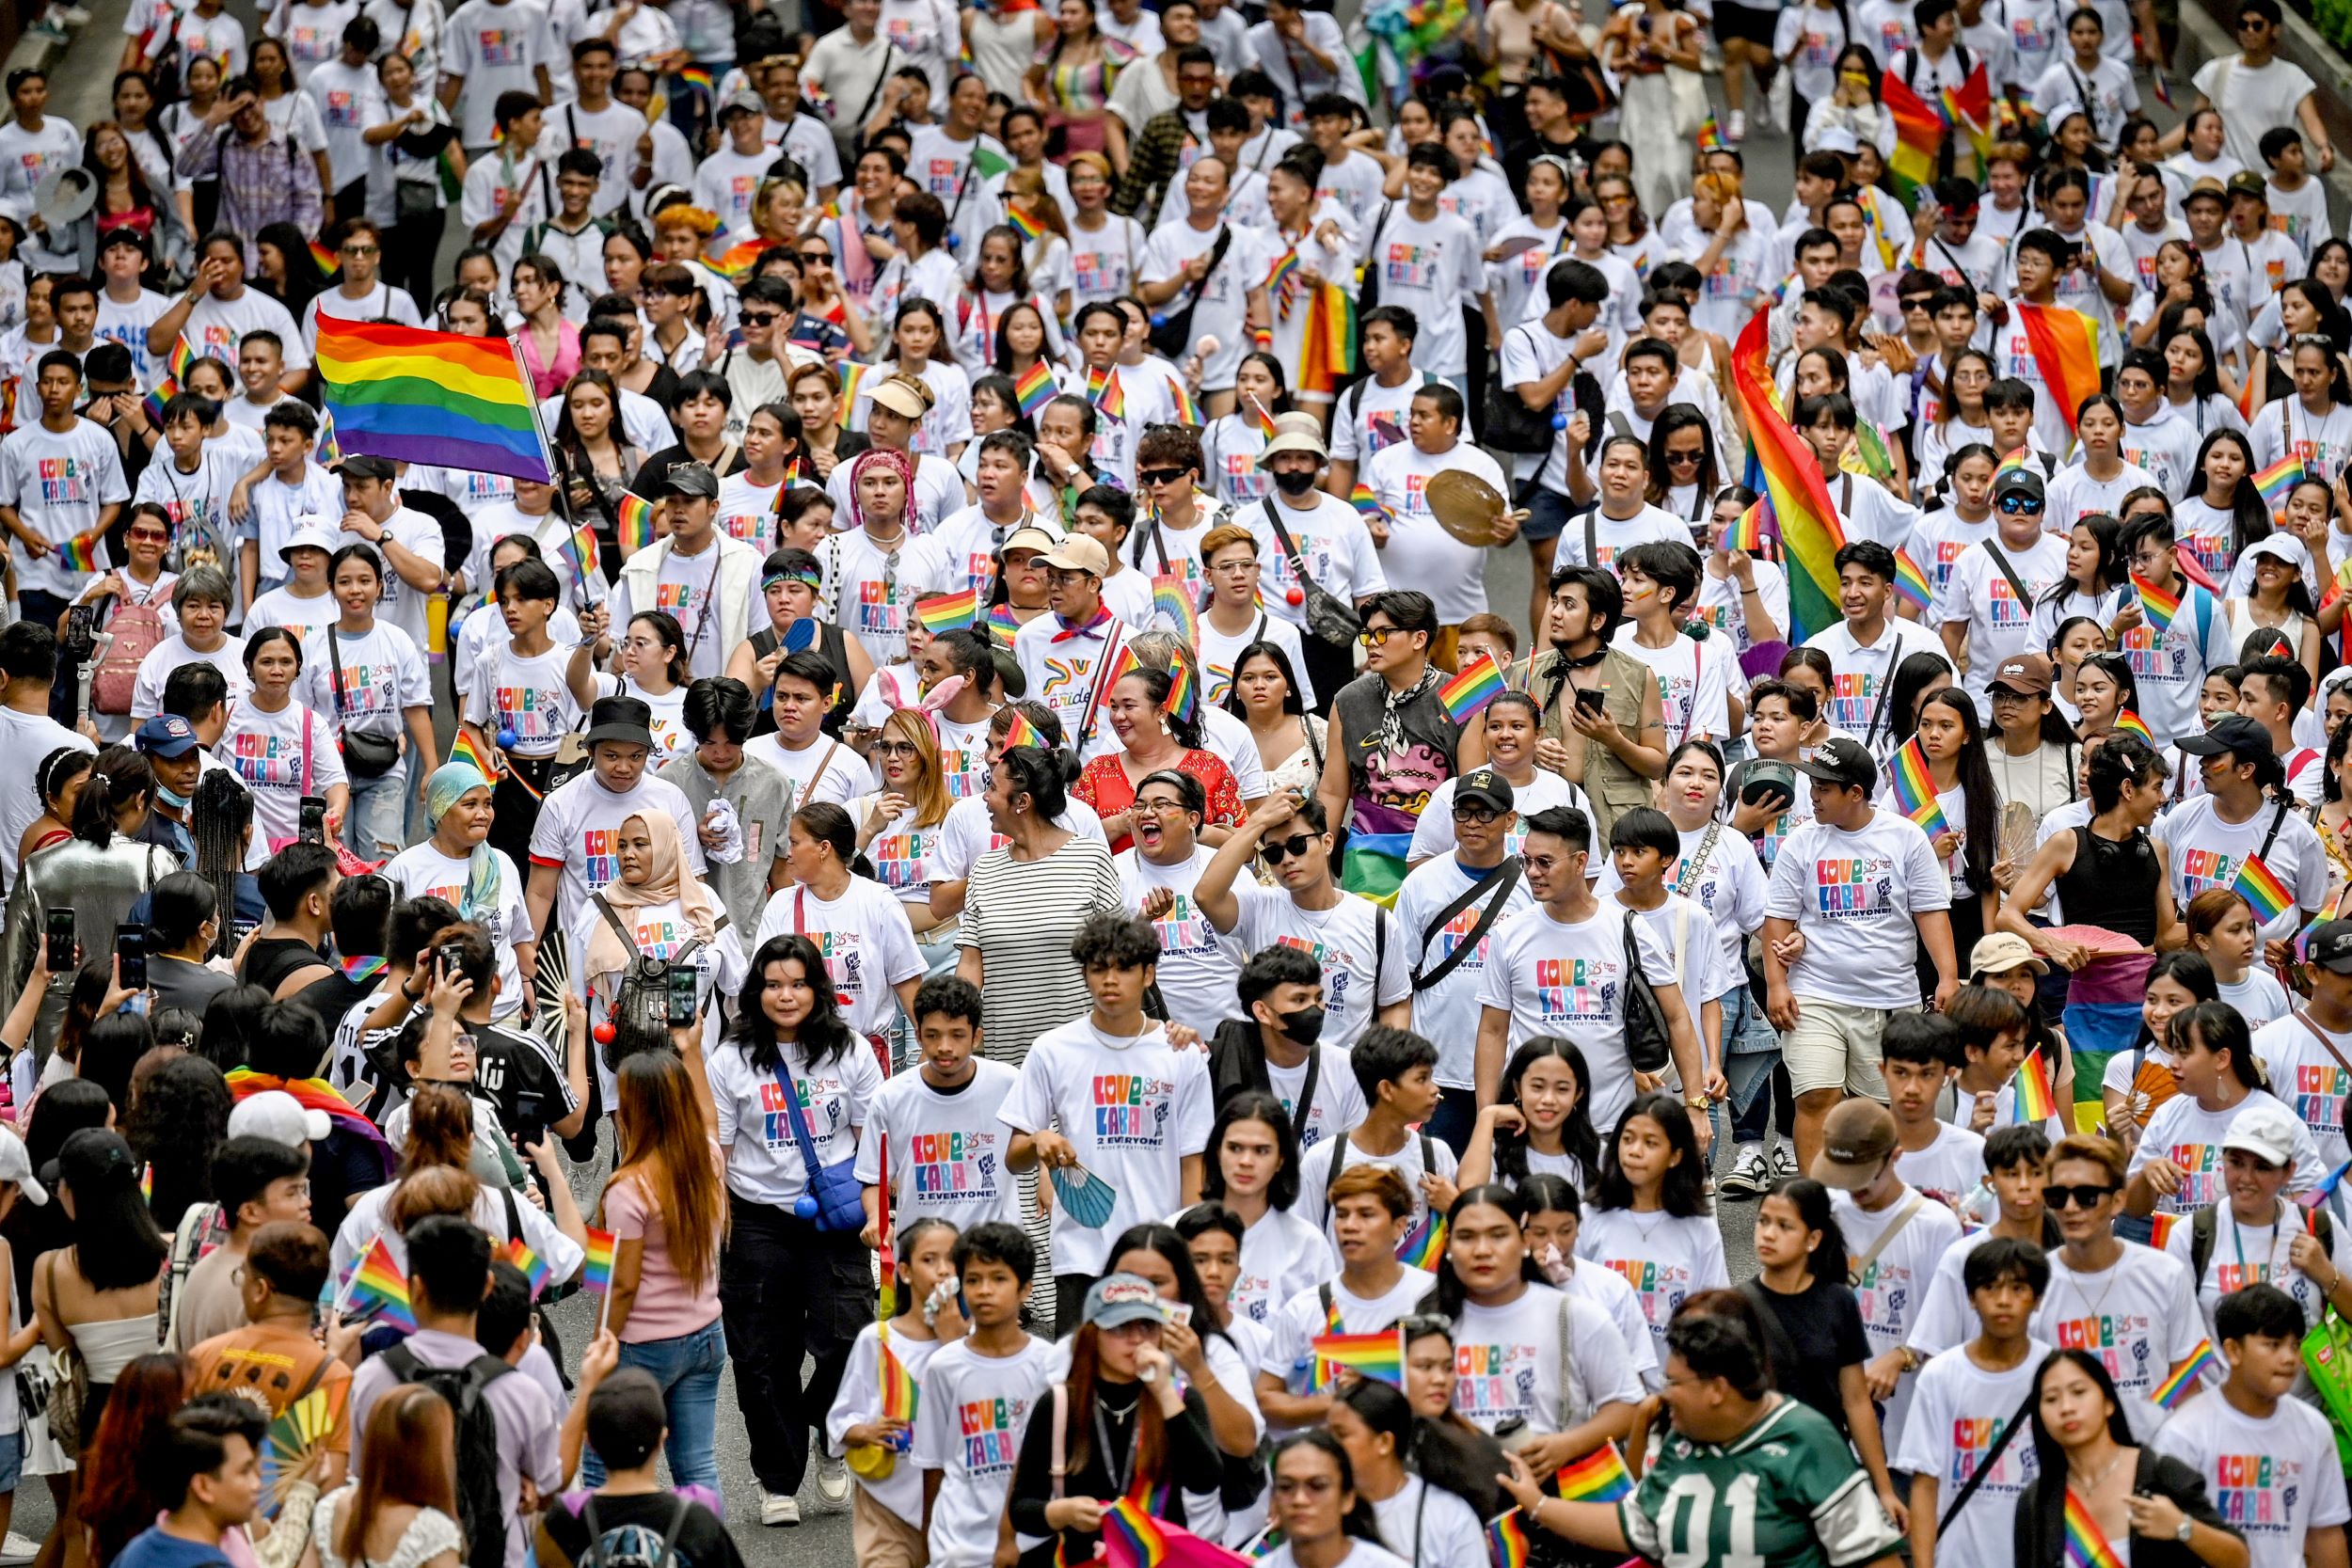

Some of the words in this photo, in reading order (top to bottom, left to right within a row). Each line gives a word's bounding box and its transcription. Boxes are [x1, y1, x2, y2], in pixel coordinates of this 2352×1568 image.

[40, 457, 75, 478] LOVE
[729, 515, 765, 539] LOVE
[2197, 536, 2229, 553] LOVE
[969, 553, 997, 576] LOV
[658, 584, 690, 608] OVE
[861, 581, 896, 605] LOVE
[2124, 626, 2161, 650] LOVE
[1834, 673, 1871, 698] LOVE
[344, 707, 395, 719] EVERYONE!
[496, 688, 533, 712] LOVE
[235, 734, 278, 759] LOVE
[941, 750, 970, 772] OVE
[942, 772, 973, 798] ABA
[584, 830, 619, 857] LOV
[878, 834, 921, 860] LOVE
[586, 857, 620, 881] LAB
[1818, 859, 1863, 885] LOVE
[2185, 848, 2229, 880] LOVE
[1830, 908, 1892, 918] EVERYONE!
[637, 922, 675, 945] OVE
[1155, 922, 1193, 948] ABA
[1536, 958, 1586, 987] LOVE
[1093, 1075, 1142, 1105] LOVE
[2297, 1065, 2347, 1095] LOVE
[760, 1079, 810, 1113] LOE
[765, 1107, 817, 1141] LAA
[768, 1140, 775, 1148] 2
[912, 1132, 963, 1164] LOVE
[2172, 1144, 2215, 1172] LOVE
[928, 1190, 996, 1200] EVERYONE!
[2058, 1316, 2114, 1350] LOVE
[1457, 1345, 1501, 1376] OVE
[1456, 1377, 1503, 1409] ABA
[959, 1399, 1009, 1436] LOVE
[2219, 1454, 2272, 1487] LOVE
[1656, 1473, 1766, 1568] 01
